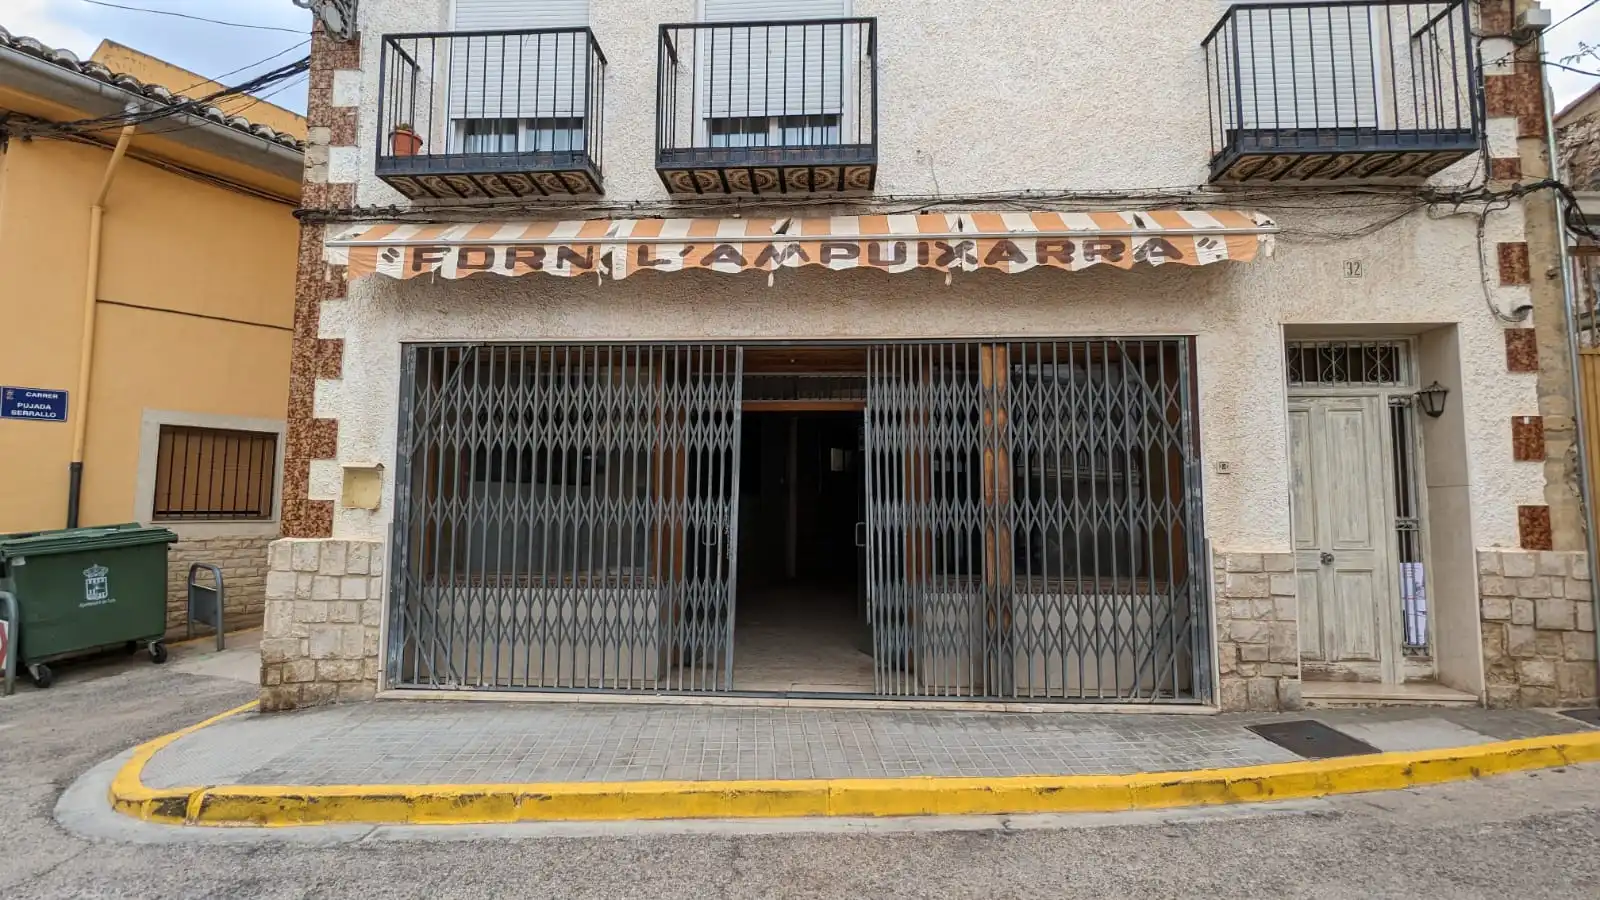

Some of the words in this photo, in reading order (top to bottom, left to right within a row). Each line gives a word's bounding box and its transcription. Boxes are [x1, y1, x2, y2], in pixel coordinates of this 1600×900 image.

[25, 391, 58, 399] CARRER
[17, 402, 52, 410] PUJADA
[11, 409, 57, 418] SERRALLO
